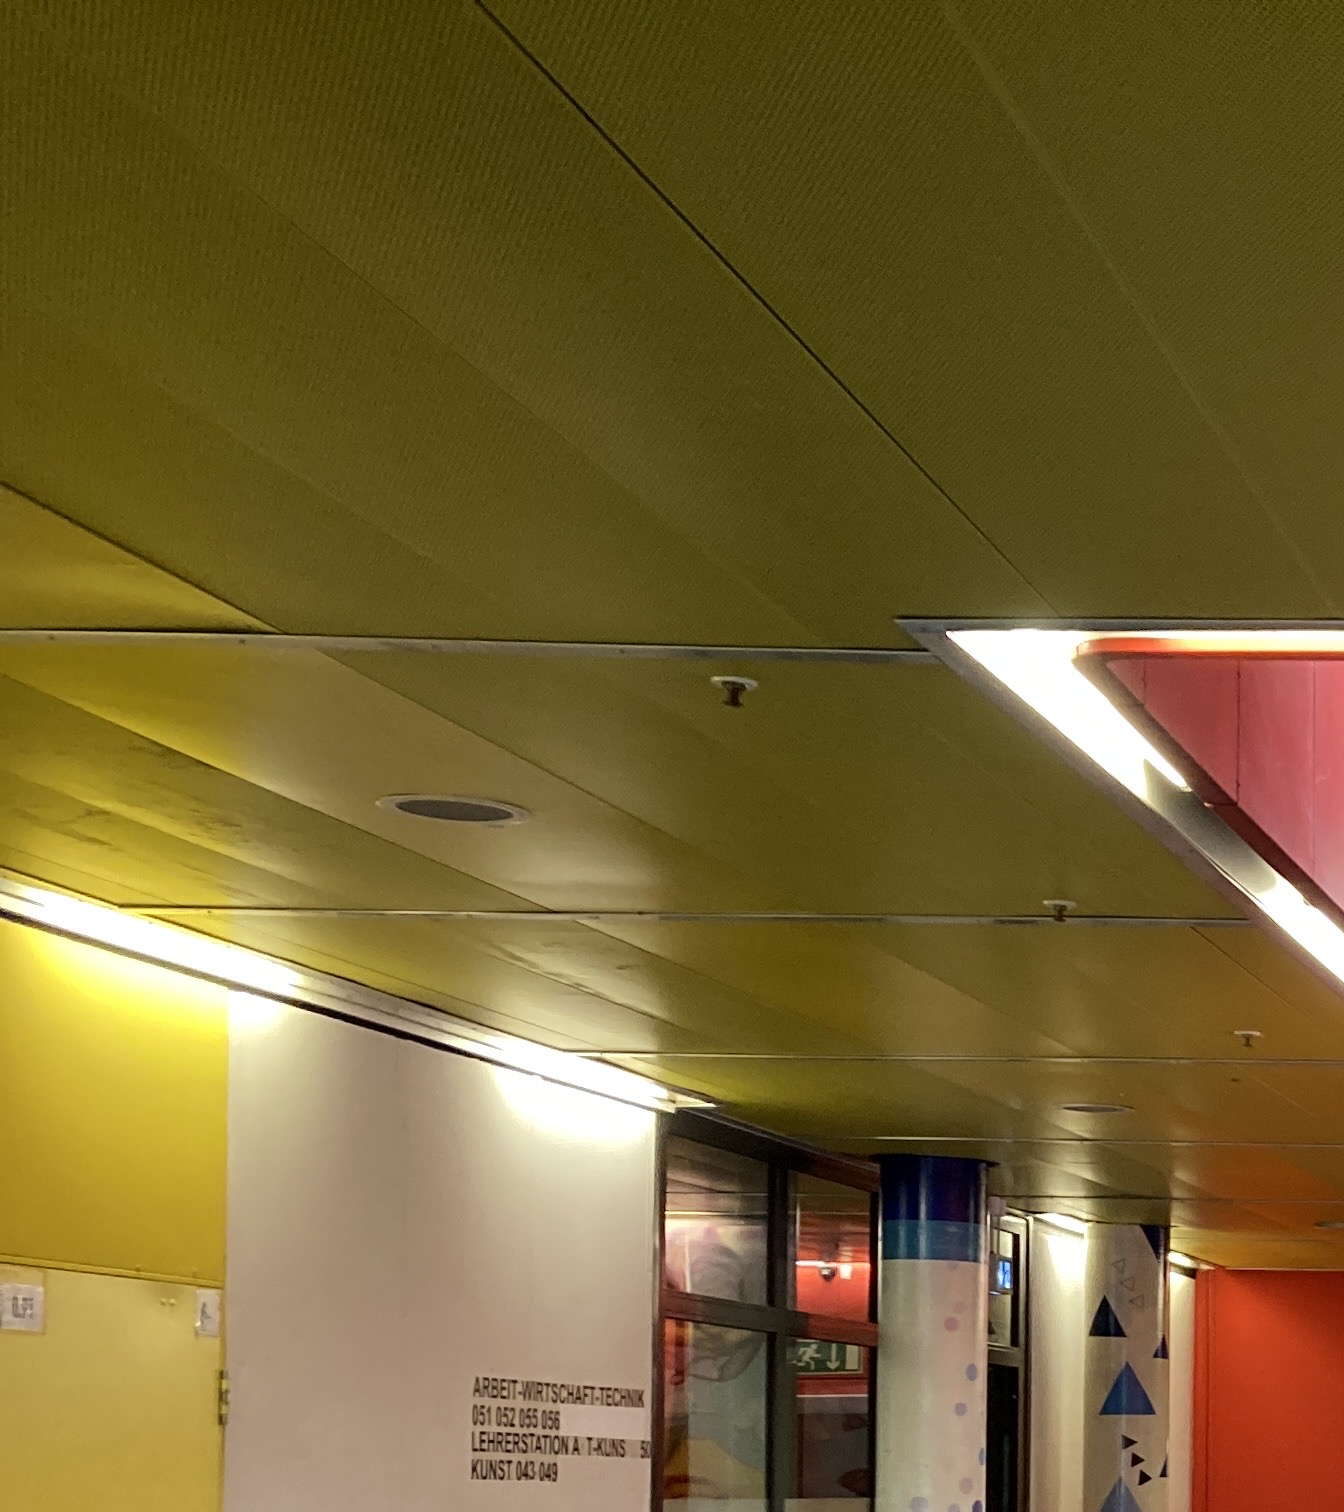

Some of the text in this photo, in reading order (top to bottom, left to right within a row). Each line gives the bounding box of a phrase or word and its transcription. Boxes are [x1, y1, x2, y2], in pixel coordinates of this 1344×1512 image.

[473, 1376, 645, 1407] ARBEIT-WIRTSCHAFT-TECHNIK
[472, 1404, 492, 1426] 051
[496, 1406, 516, 1427] 052
[541, 1410, 560, 1430] 056
[471, 1431, 569, 1455] LEHRERSTATION
[470, 1458, 558, 1482] KUNST 043 049
